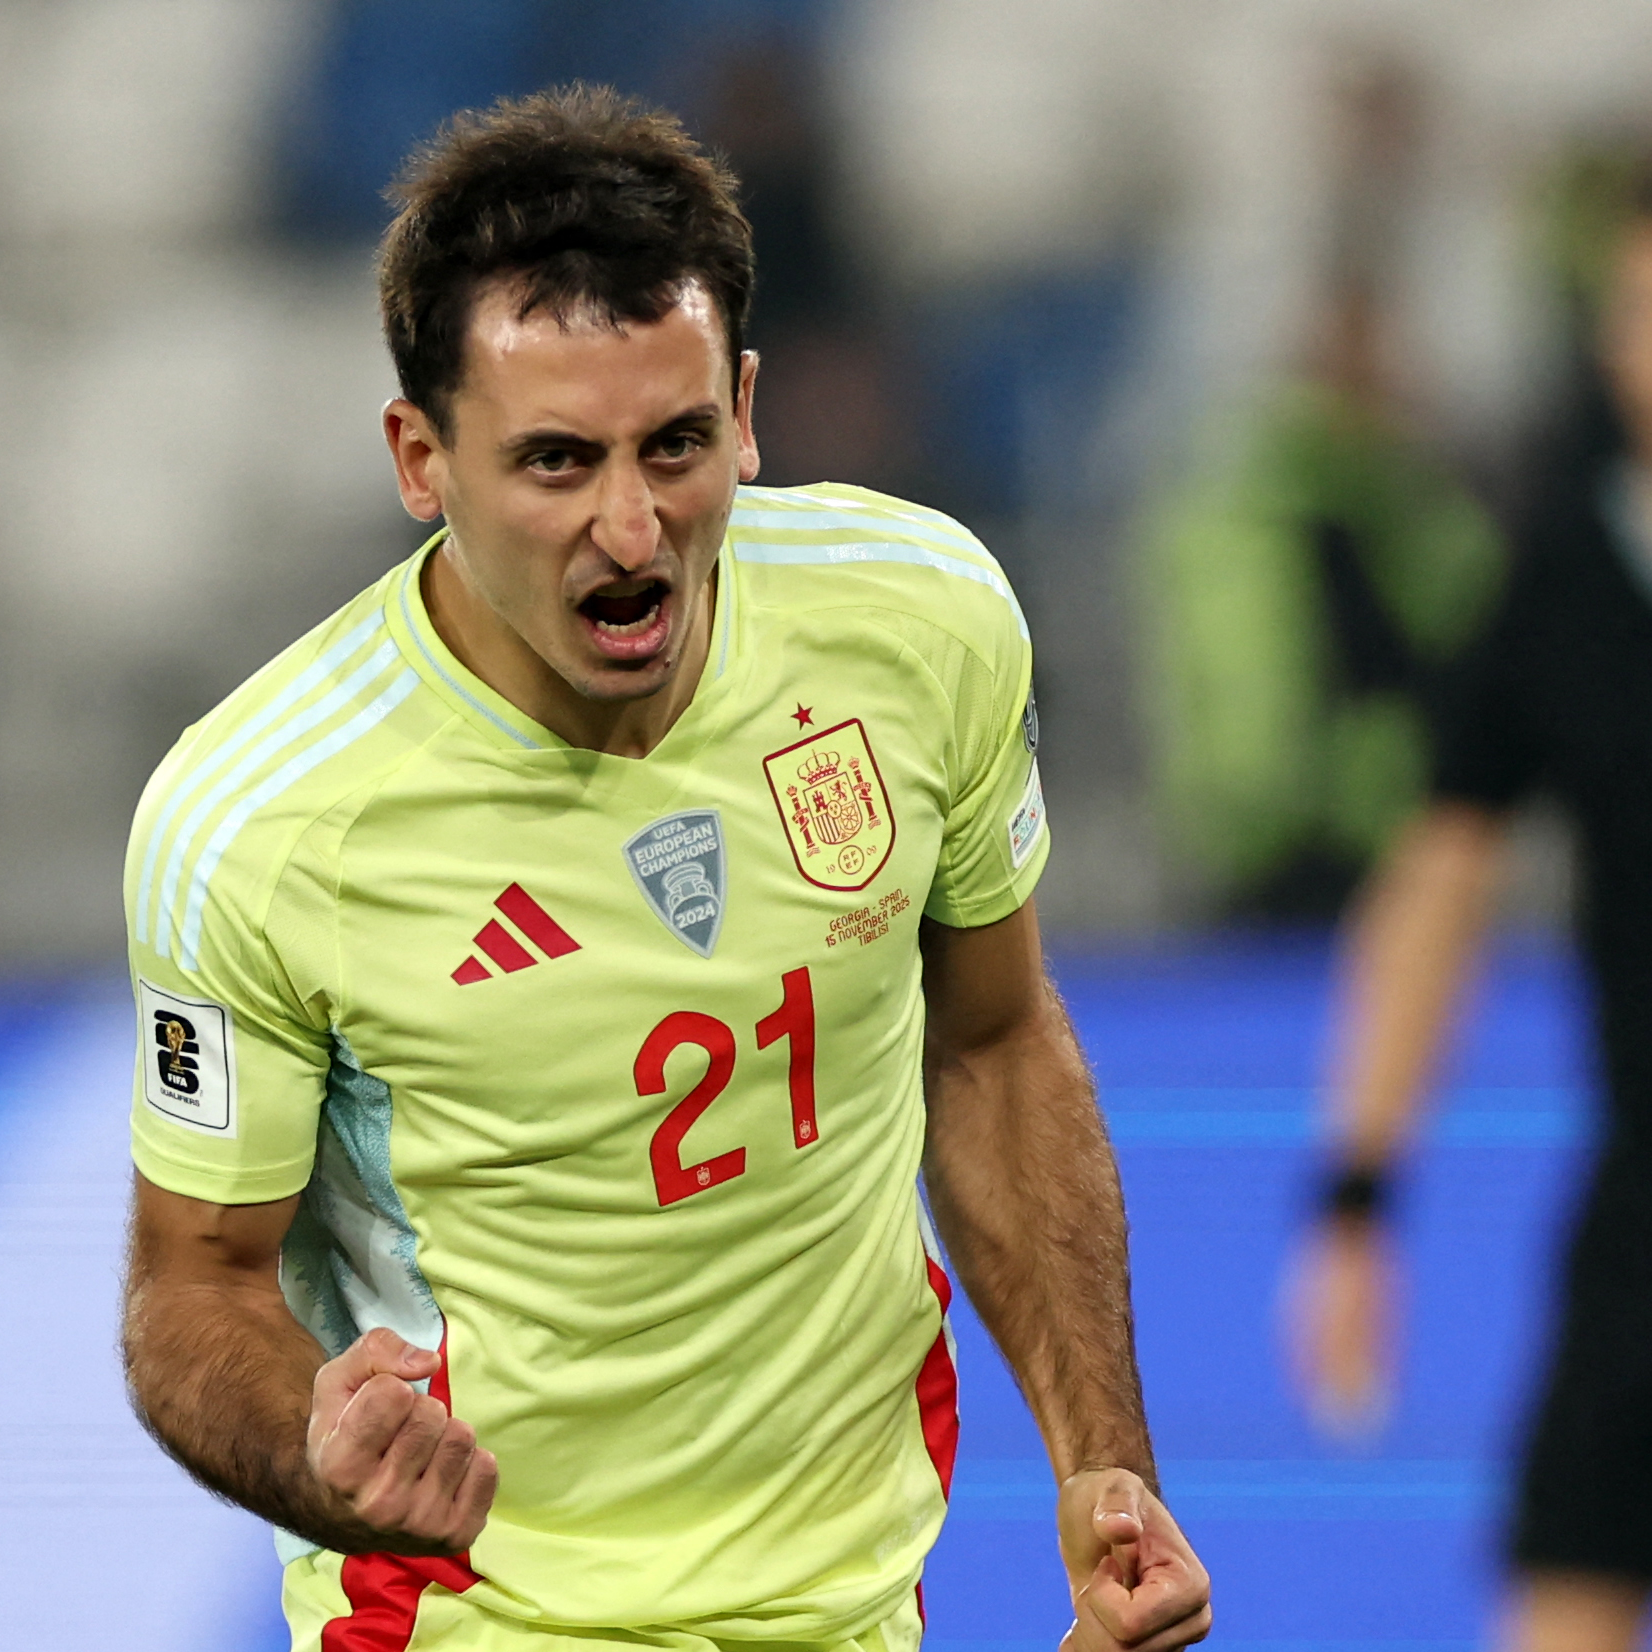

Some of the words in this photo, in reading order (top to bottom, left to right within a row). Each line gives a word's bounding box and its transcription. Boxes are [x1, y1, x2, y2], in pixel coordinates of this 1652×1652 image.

[635, 822, 713, 863] EUROPEAN
[653, 821, 686, 840] UEFA
[639, 838, 718, 877] CHAMPIONS
[675, 902, 715, 929] 2024
[825, 933, 837, 947] 15
[838, 910, 888, 943] NOVEMBER
[891, 895, 910, 917] 2025
[829, 907, 870, 932] GEORGIA
[878, 888, 903, 910] SPAIN
[160, 1086, 201, 1108] QUALIFIERS
[167, 1072, 188, 1088] FIFA
[633, 966, 819, 1207] 21
